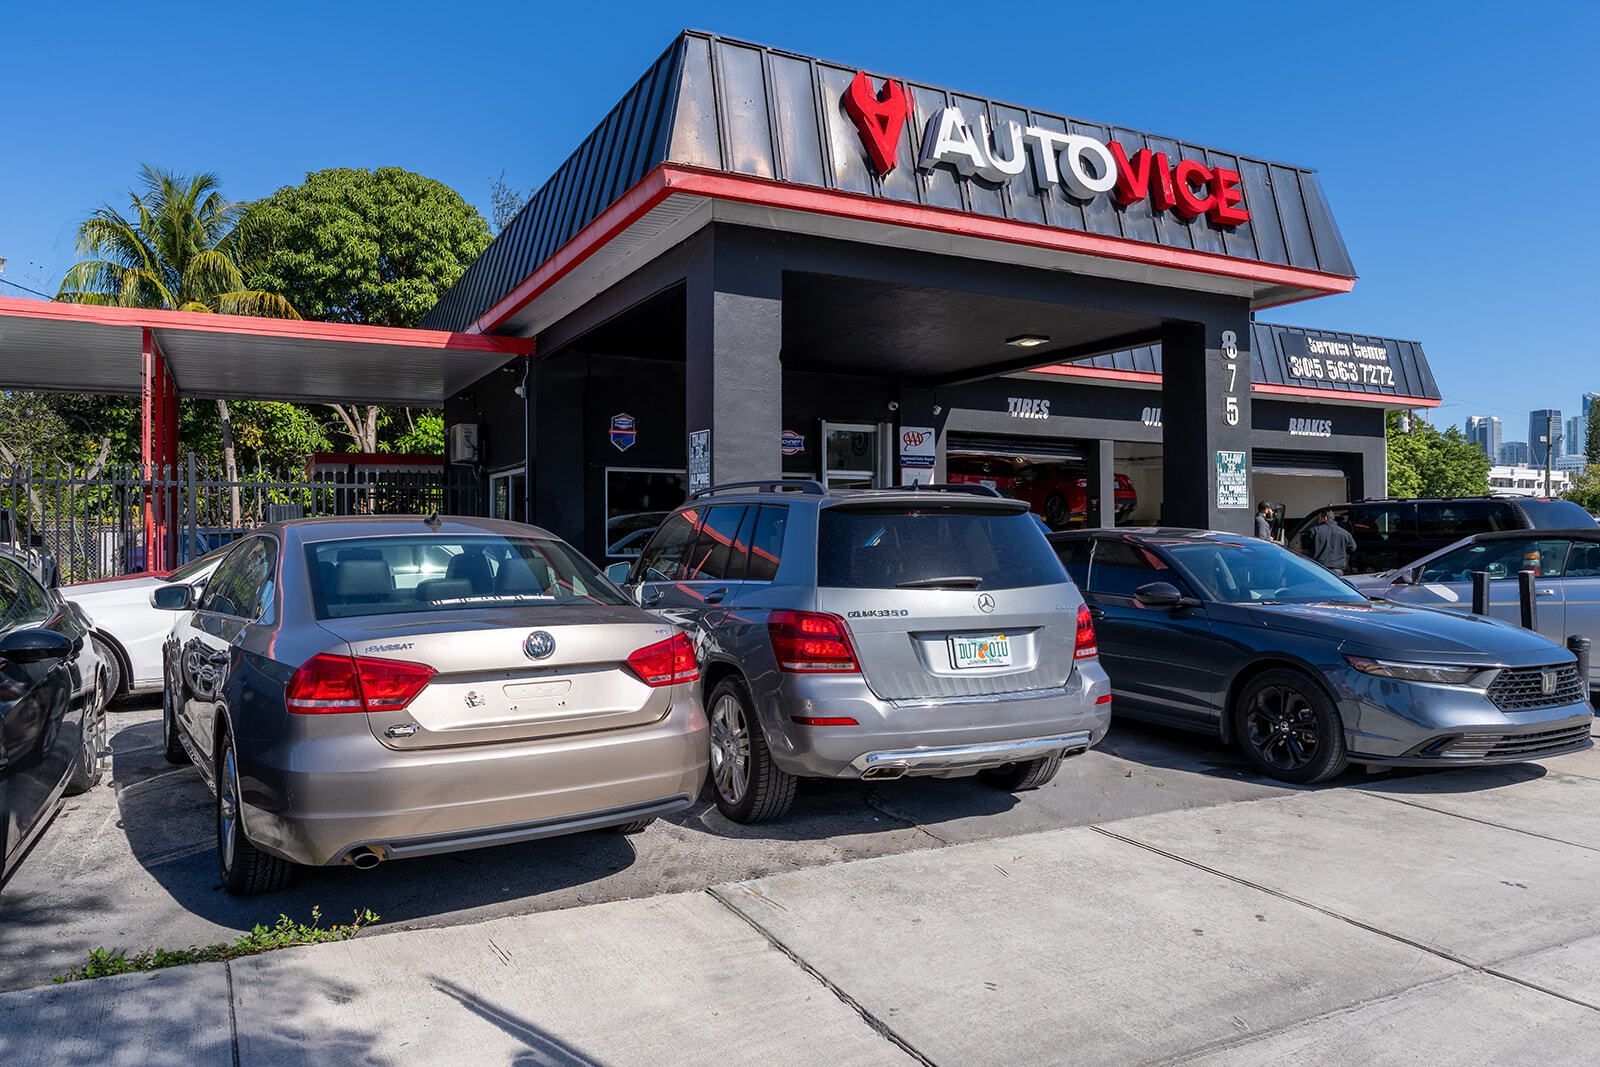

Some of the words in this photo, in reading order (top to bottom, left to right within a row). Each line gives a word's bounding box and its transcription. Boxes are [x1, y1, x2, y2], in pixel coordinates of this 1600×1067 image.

[918, 106, 1250, 226] AUTOVICE
[1221, 330, 1239, 426] 875
[1290, 355, 1324, 379] 305
[1326, 359, 1359, 382] 563
[1360, 363, 1395, 386] 7272
[1007, 397, 1050, 419] TIRES
[1288, 417, 1332, 438] BRAKES
[904, 432, 922, 446] AAA
[1219, 485, 1247, 494] ALPINE
